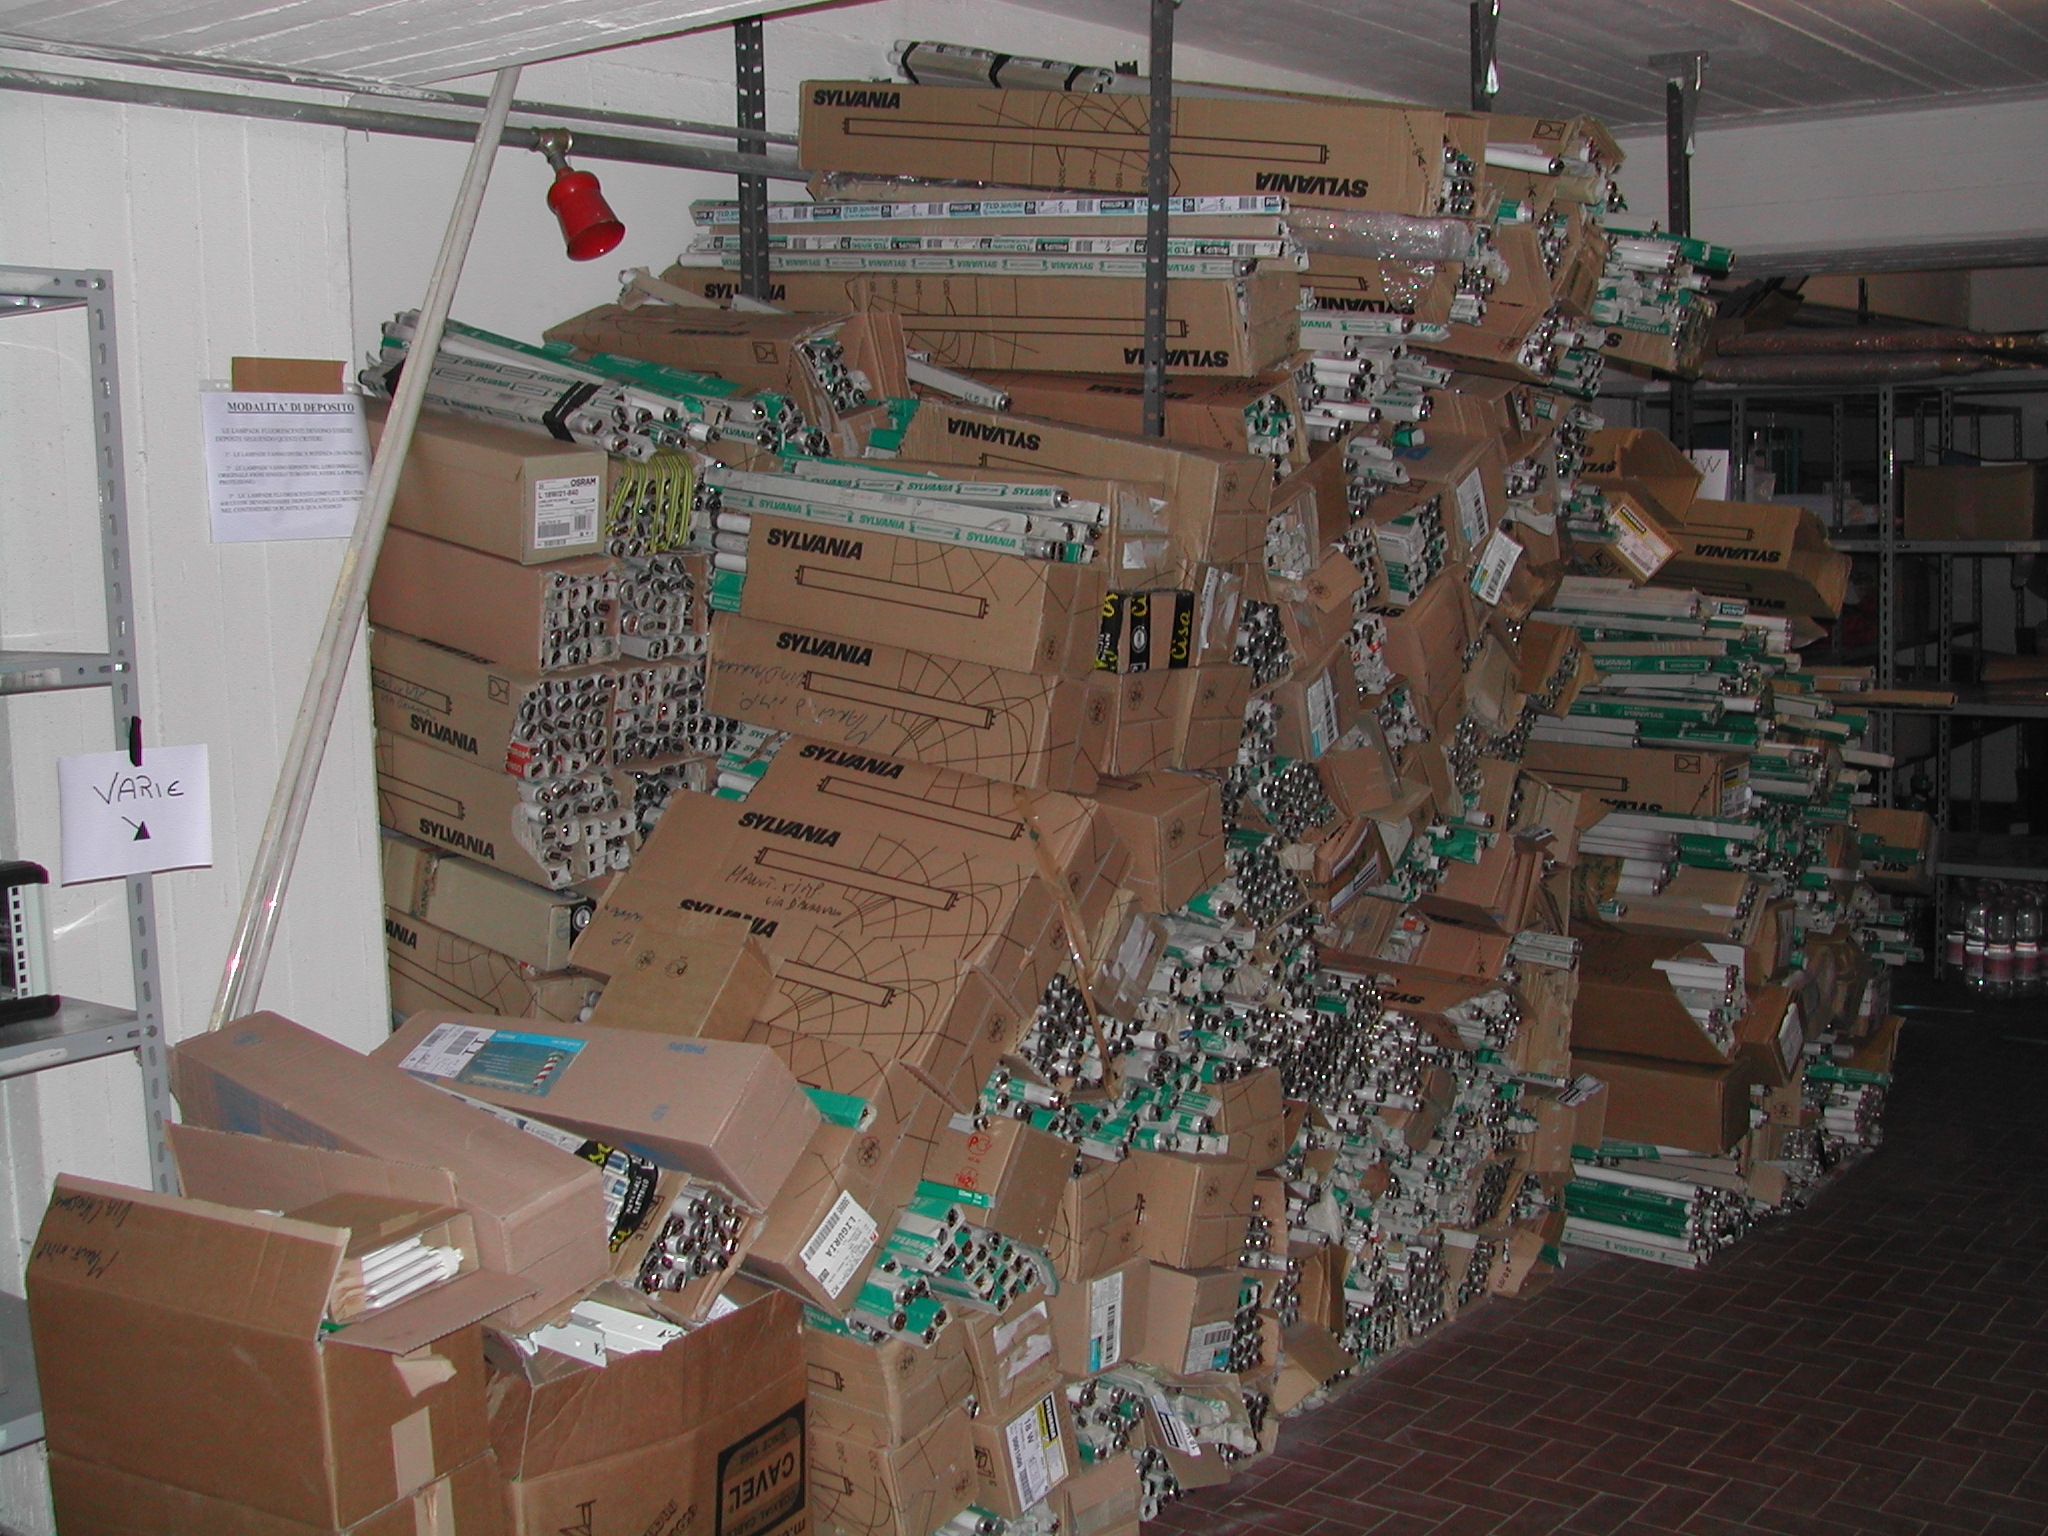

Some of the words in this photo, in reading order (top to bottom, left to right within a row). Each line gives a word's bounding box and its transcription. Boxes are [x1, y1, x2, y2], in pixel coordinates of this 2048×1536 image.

[813, 89, 901, 109] SYLVANIA
[1256, 172, 1369, 198] SYLVANIA
[1123, 348, 1229, 368] SYLVAIA
[290, 402, 301, 413] DI
[303, 402, 355, 413] DEPOSITO
[722, 427, 755, 440] YLVANIA
[946, 417, 1041, 451] SYLVANIA
[570, 477, 597, 487] OSRAM
[906, 482, 953, 492] SYLVANIA
[758, 500, 801, 514] SYLVANIA
[858, 514, 905, 531] SYLVANIA
[767, 528, 863, 561] SYLVANIA
[966, 531, 1017, 548] SYLVANIA
[1695, 543, 1781, 563] SYLVANIA
[777, 632, 873, 667] SYLVANIA
[411, 714, 478, 756] SYLVANIA
[799, 745, 904, 780] SYLVANIA
[93, 771, 184, 805] VARIE
[419, 818, 496, 861] SYLVANIA
[738, 812, 842, 848] SYLVANIA
[825, 1215, 856, 1257] LIGURIA
[729, 1451, 796, 1510] CAVEL
